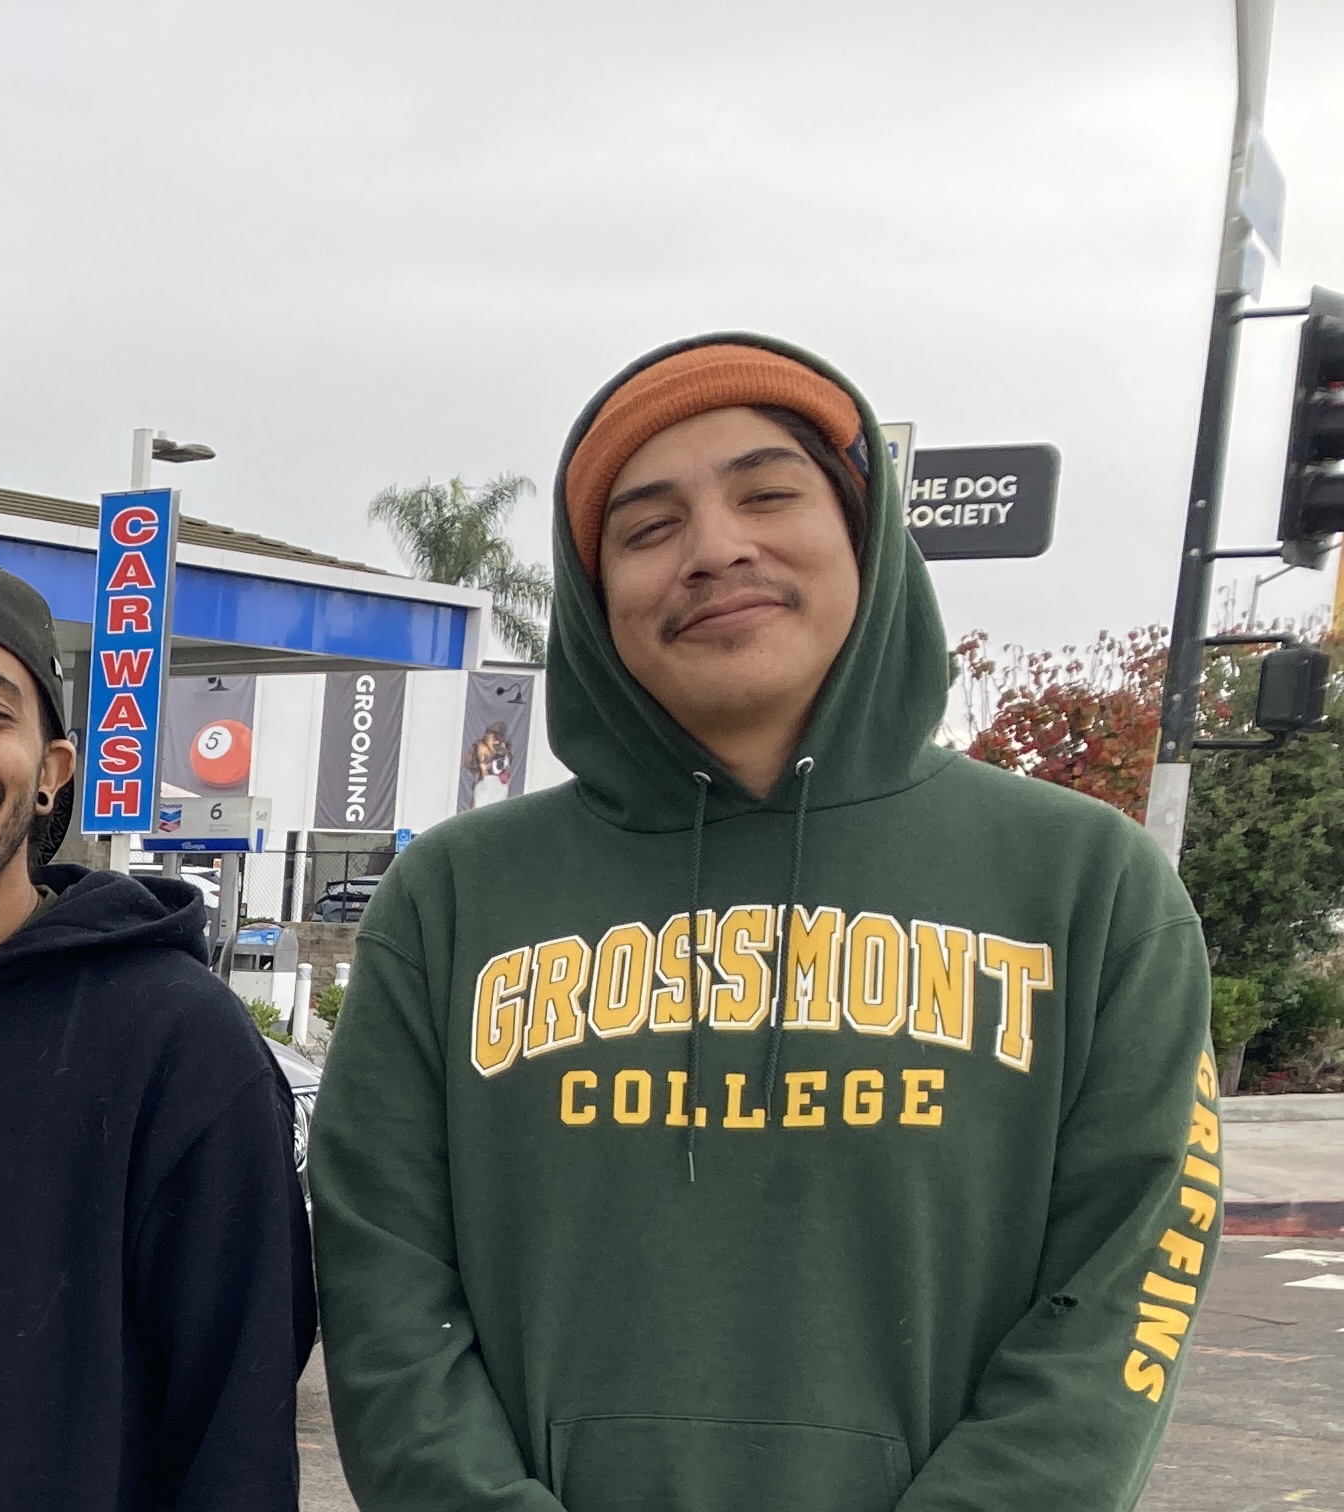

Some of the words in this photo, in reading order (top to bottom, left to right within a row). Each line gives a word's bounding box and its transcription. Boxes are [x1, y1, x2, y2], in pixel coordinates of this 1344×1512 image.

[909, 477, 948, 501] HE
[954, 474, 1018, 499] DOG
[105, 506, 160, 635] CAR
[94, 647, 155, 818] WASH
[205, 731, 223, 750] 5
[345, 674, 376, 822] GROOMING
[210, 802, 223, 821] 6
[469, 904, 1054, 1078] GROSSMONT
[559, 1069, 946, 1129] COLLEGE
